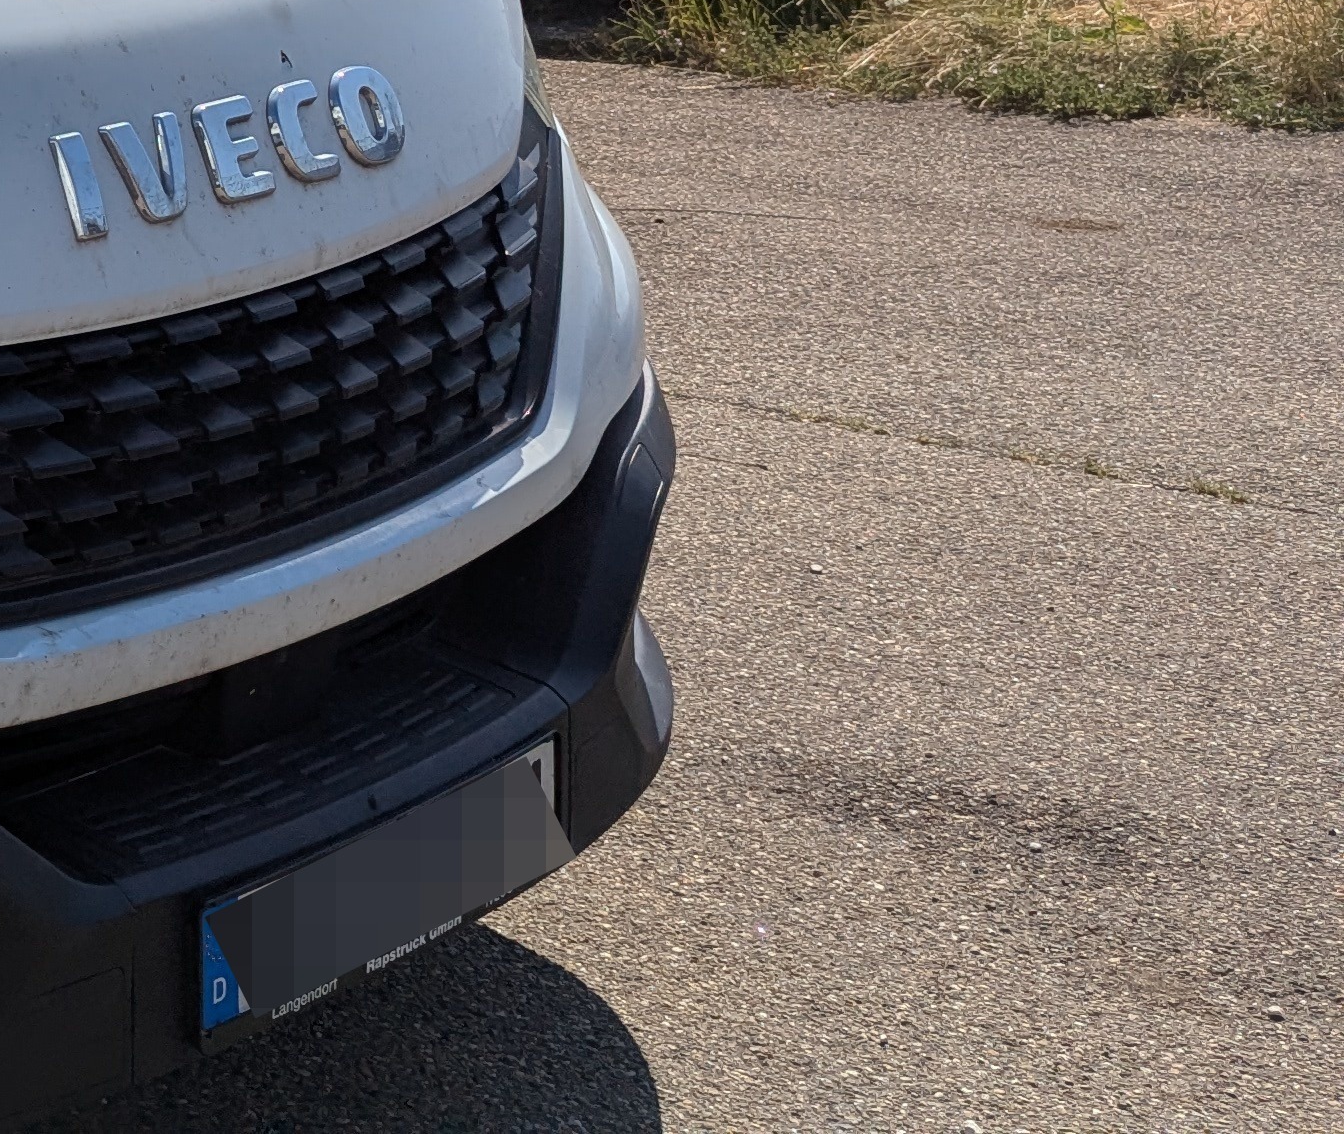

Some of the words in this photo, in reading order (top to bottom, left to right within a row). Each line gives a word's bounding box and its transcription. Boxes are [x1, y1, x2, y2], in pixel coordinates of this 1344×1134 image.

[48, 65, 406, 243] IVECO
[213, 976, 227, 1005] D
[272, 977, 338, 1020] Langendorf
[366, 934, 427, 974] Rapstruck
